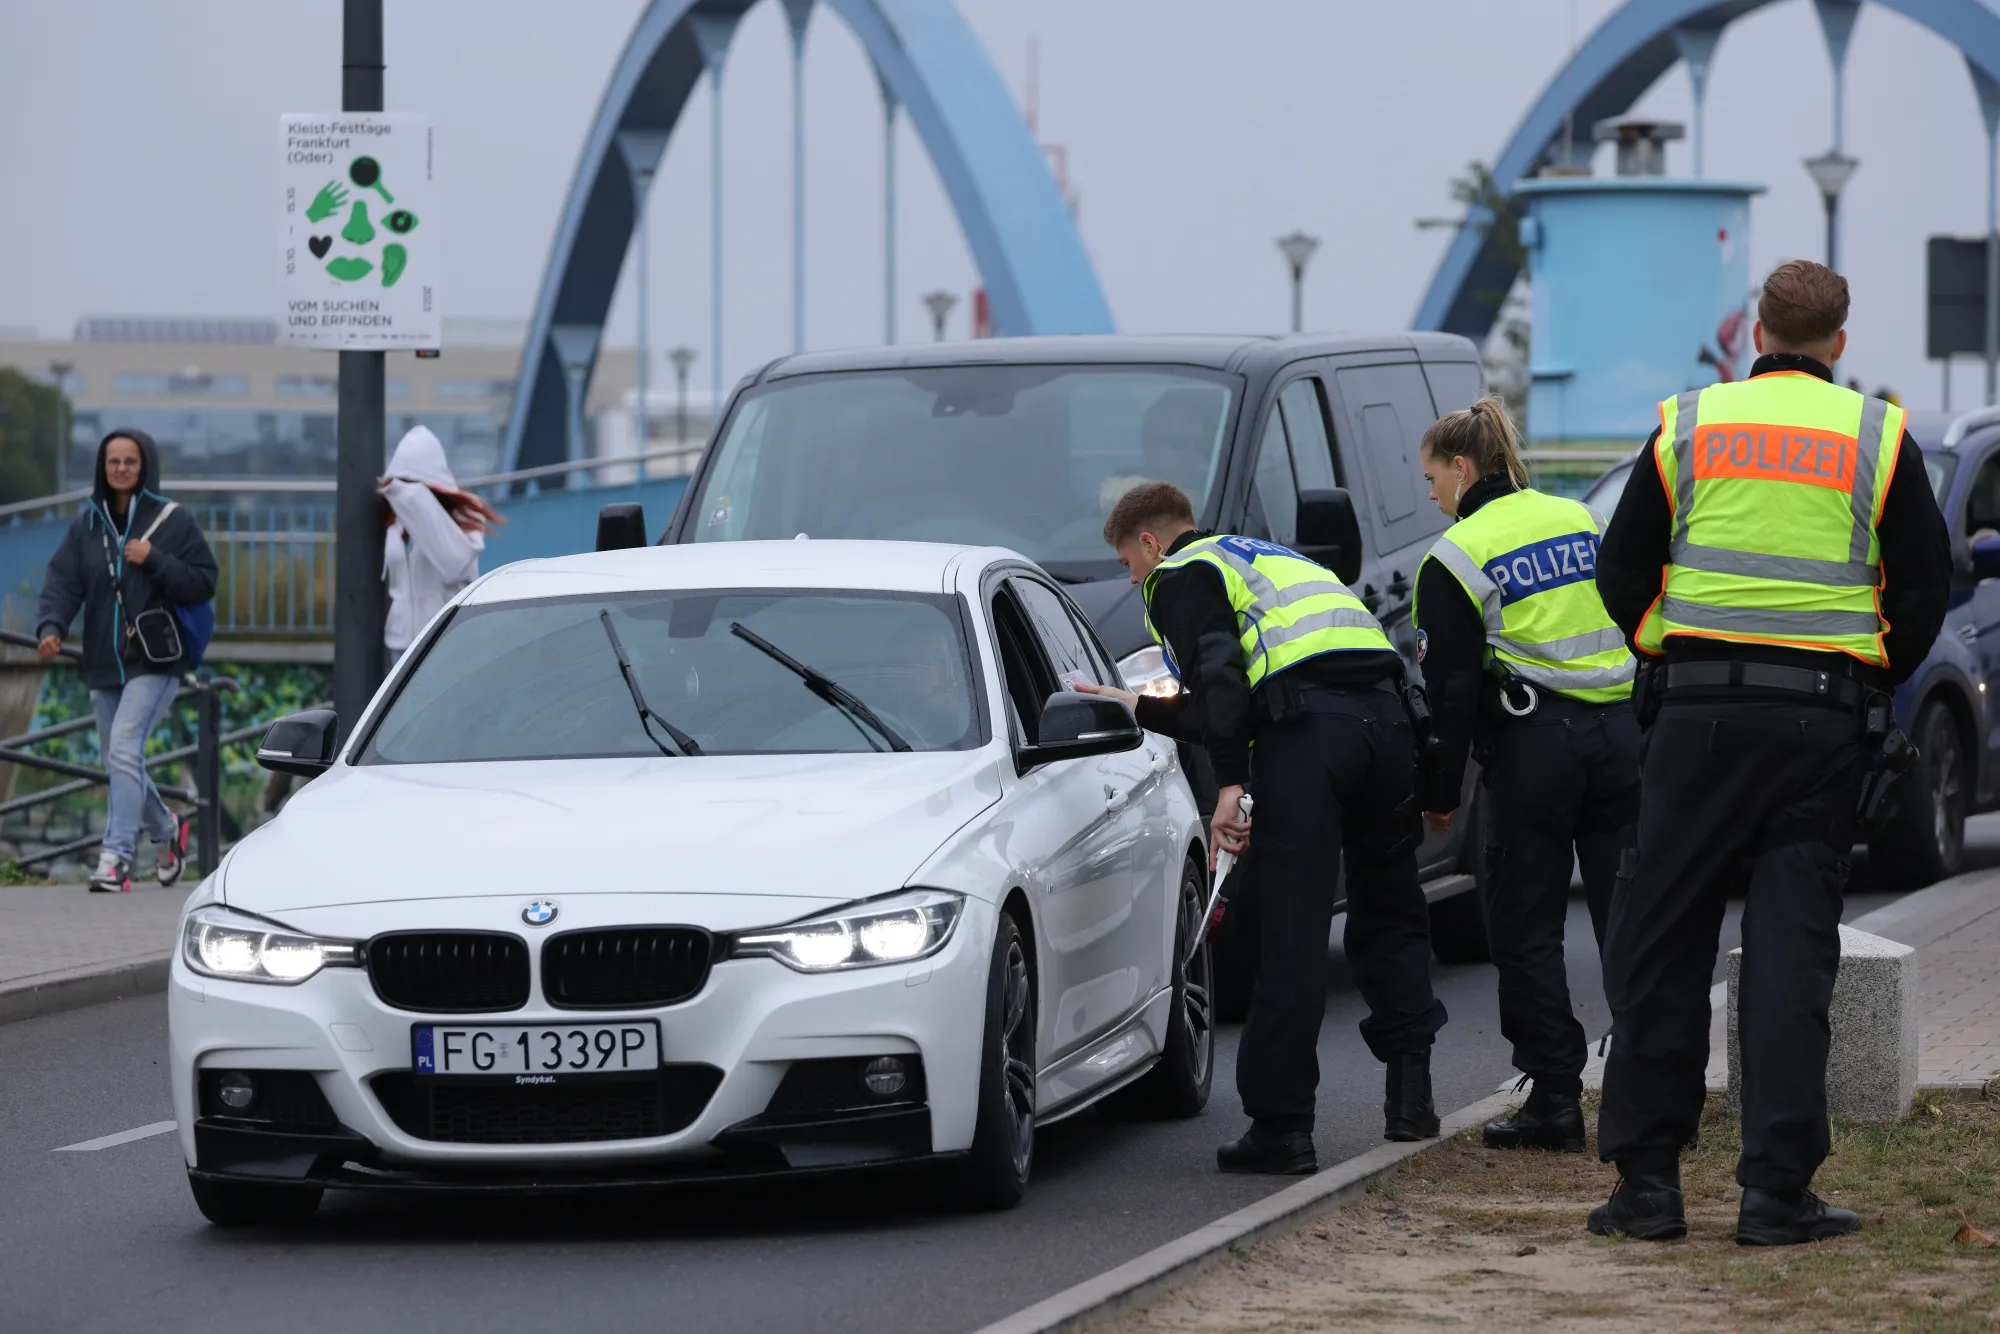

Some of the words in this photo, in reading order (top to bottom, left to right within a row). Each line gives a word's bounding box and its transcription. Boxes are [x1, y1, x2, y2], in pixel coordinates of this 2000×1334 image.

[288, 122, 392, 136] Kleist-Festtage
[287, 137, 350, 149] Frankfurt
[287, 152, 334, 165] (Oder)
[288, 300, 318, 312] VOM
[322, 300, 380, 312] SUCHEN
[288, 314, 318, 327] UND
[321, 314, 392, 327] ERFINDEN
[1705, 431, 1847, 480] POLIZEI
[1490, 539, 1597, 597] POLIZEI
[418, 1055, 433, 1068] PL
